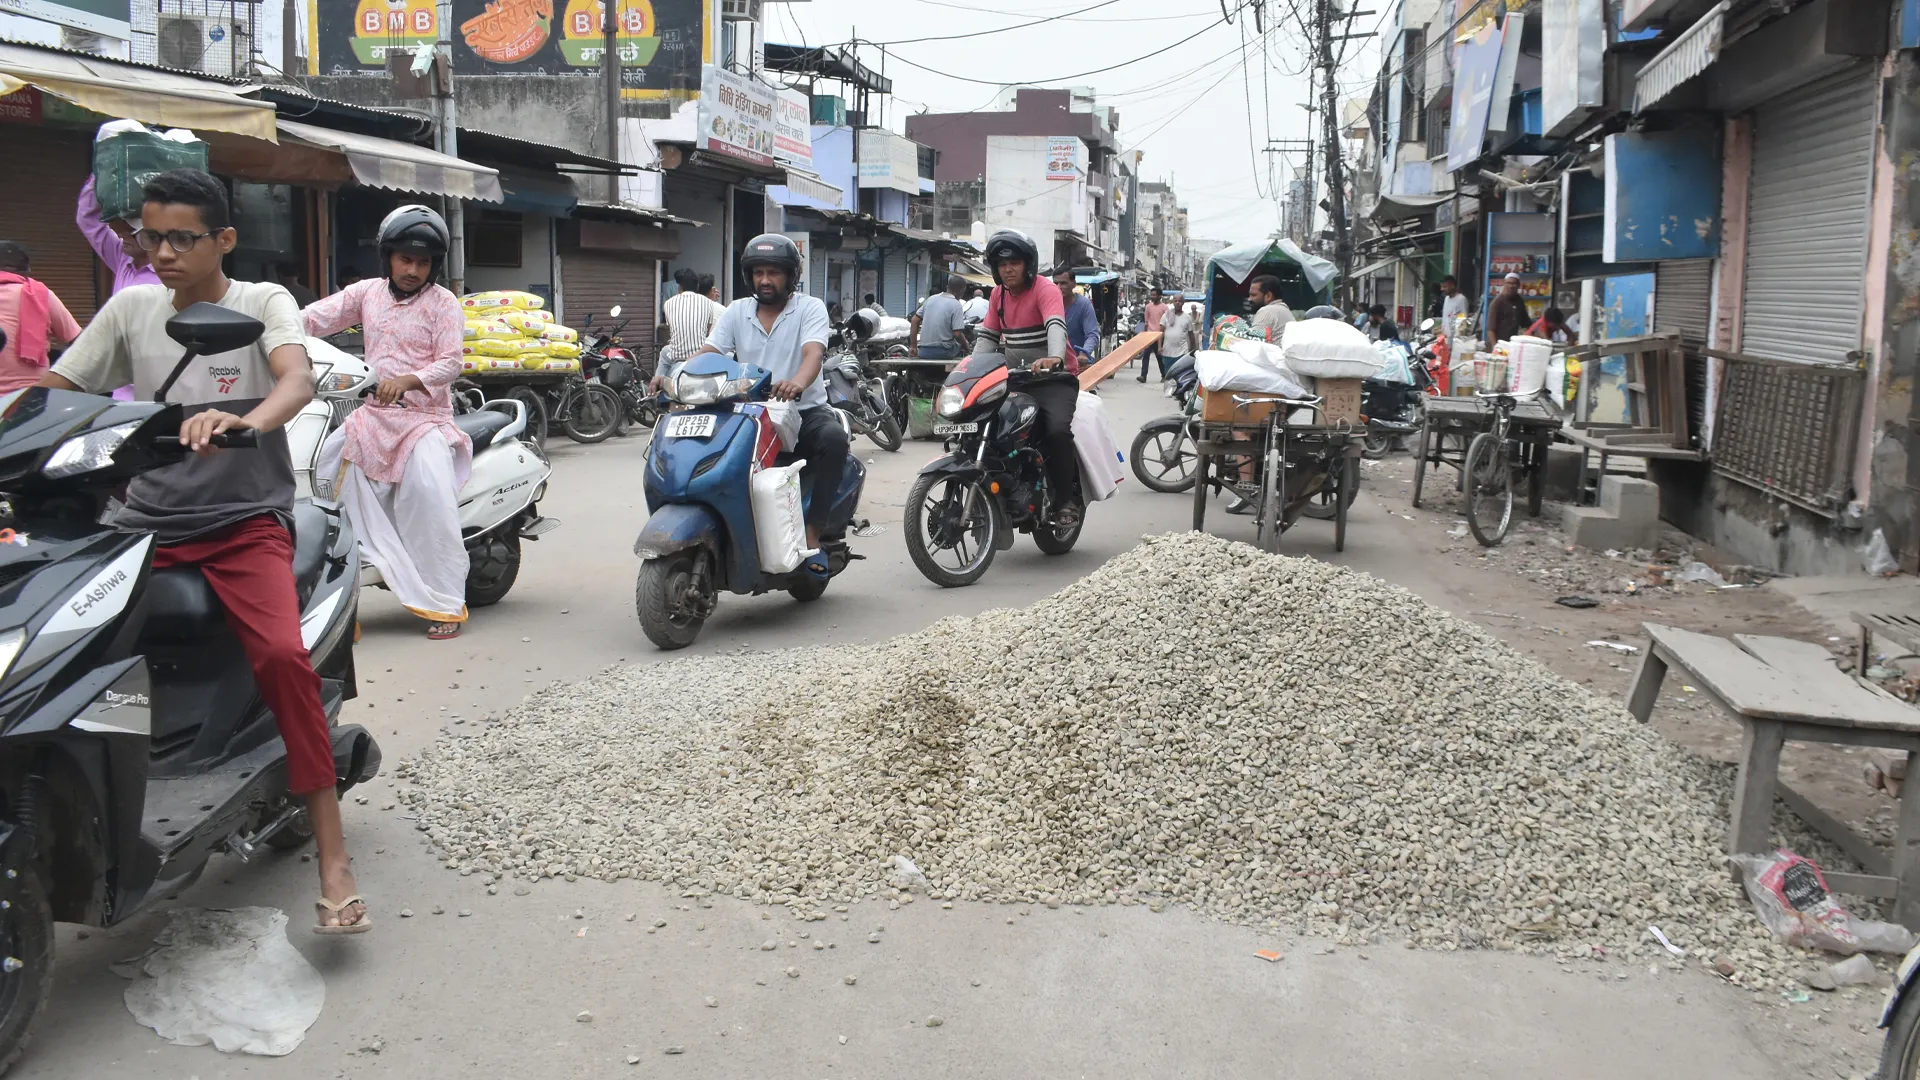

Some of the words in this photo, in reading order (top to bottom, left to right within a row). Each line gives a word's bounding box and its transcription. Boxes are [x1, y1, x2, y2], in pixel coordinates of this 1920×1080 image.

[575, 11, 642, 33] BB
[718, 83, 734, 107] विधि
[209, 365, 241, 379] Reebok
[679, 415, 710, 426] UP25B
[676, 425, 707, 435] L6177
[492, 480, 529, 497] Activa
[70, 569, 127, 617] E-Ashwa
[136, 693, 149, 705] Pro
